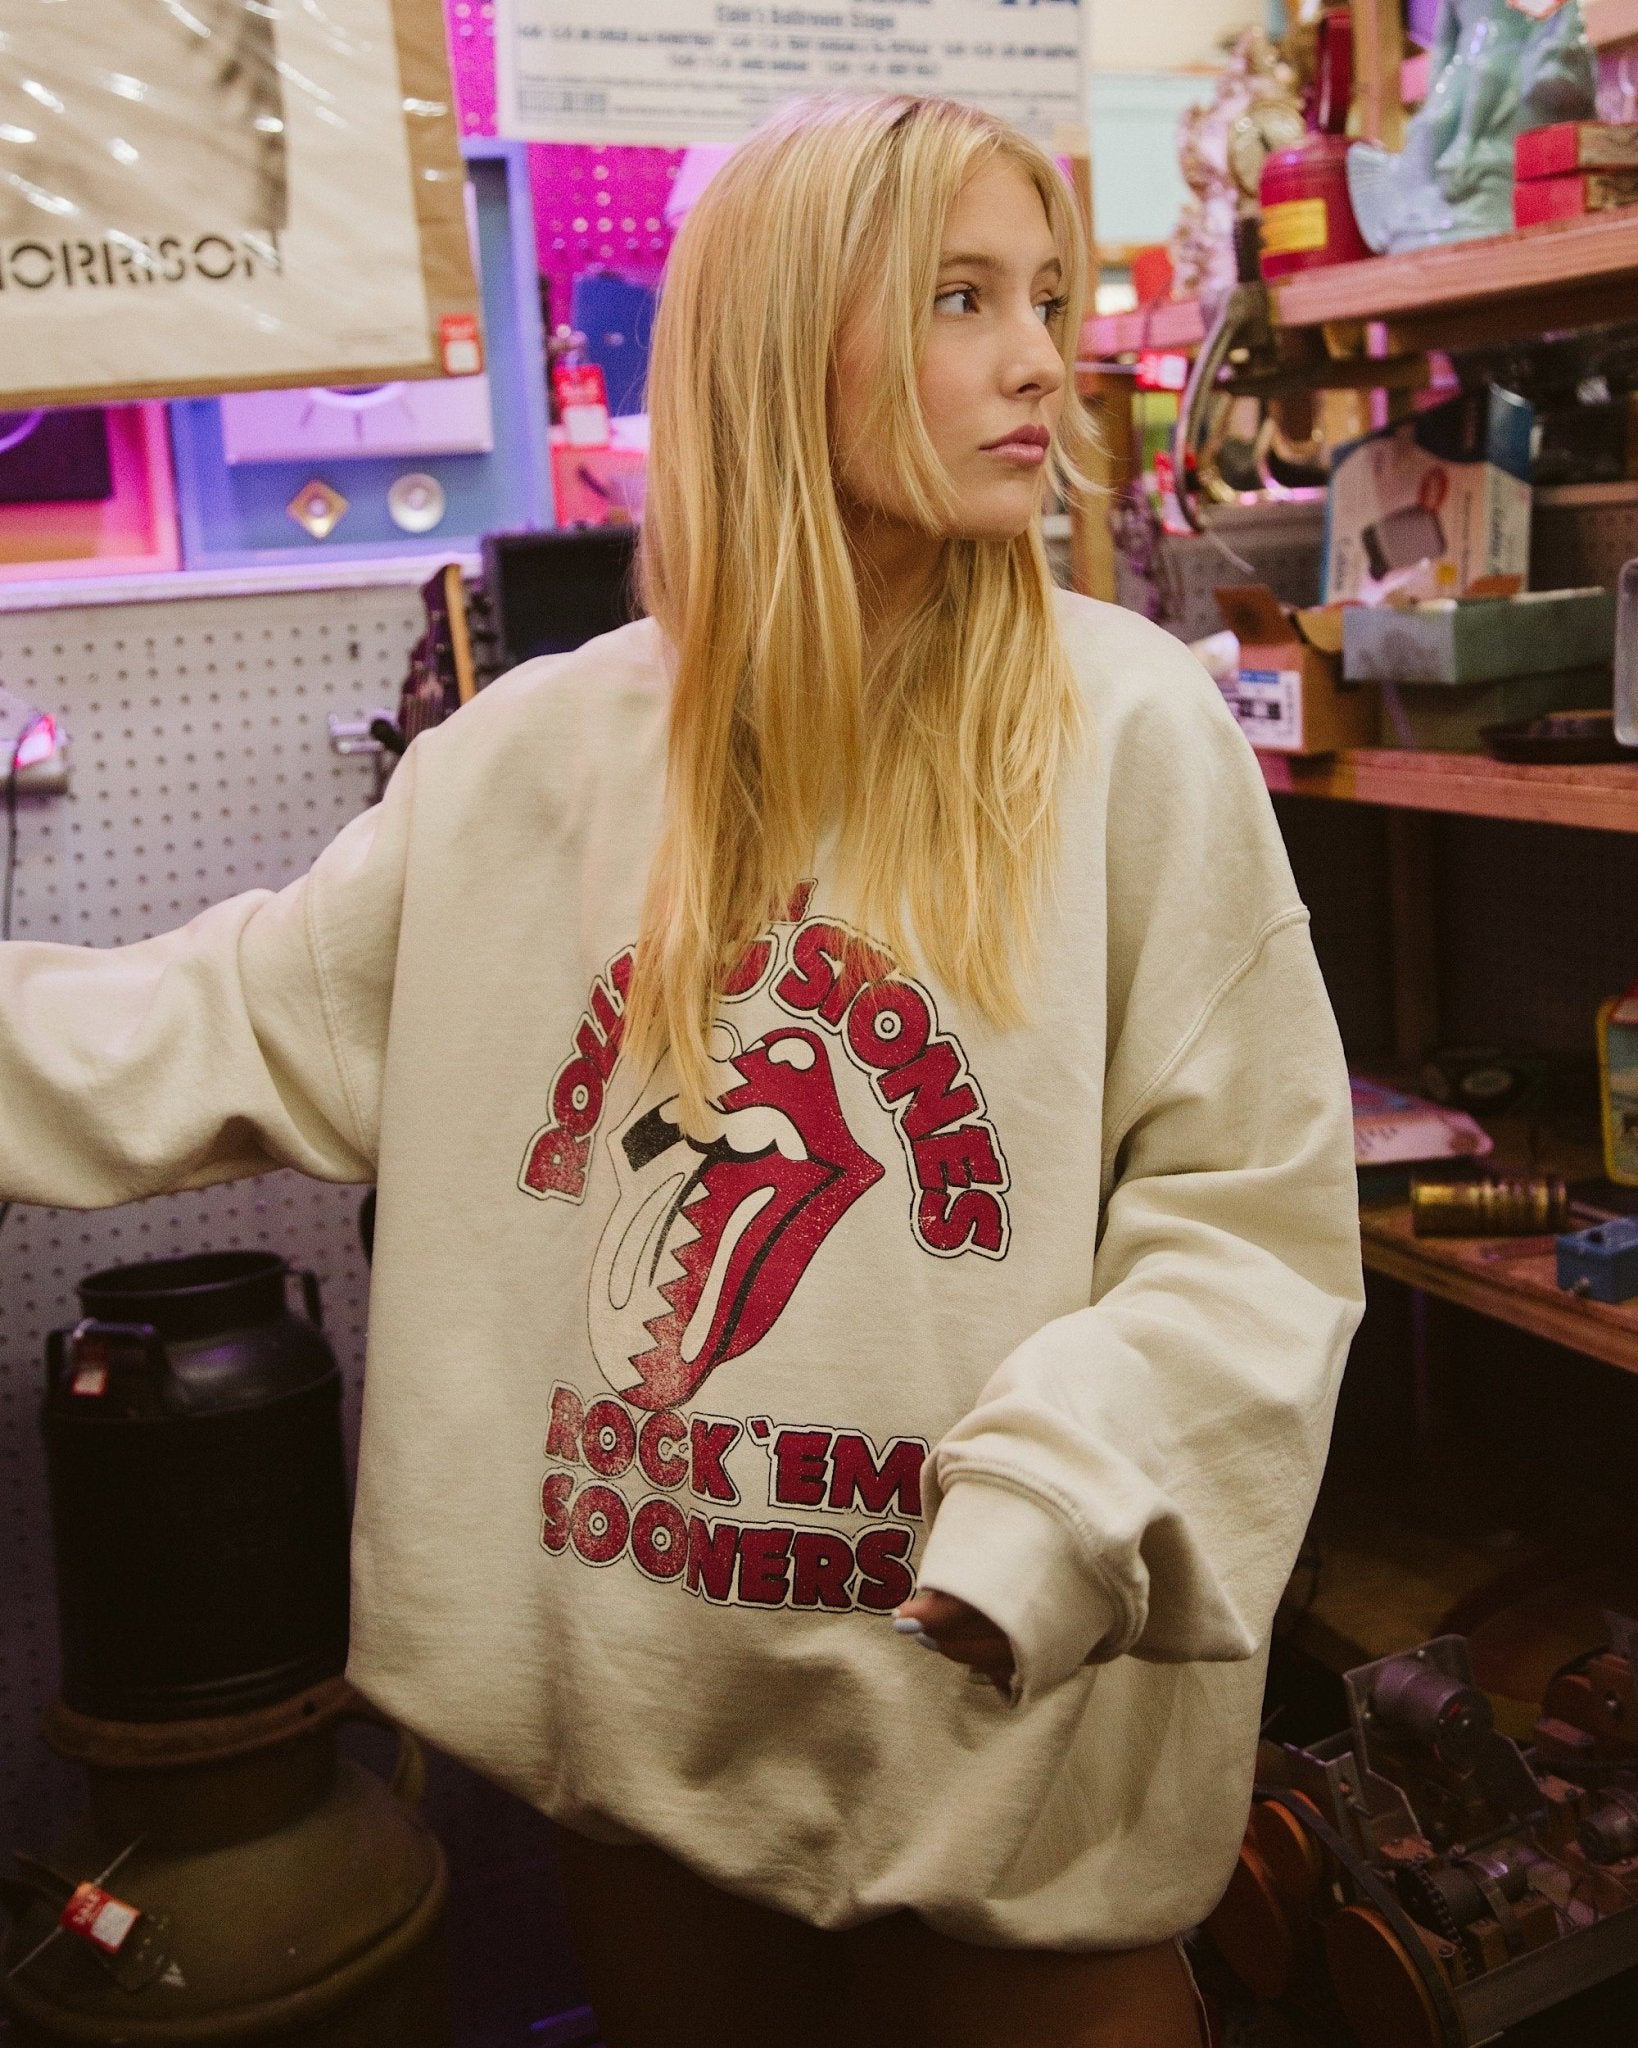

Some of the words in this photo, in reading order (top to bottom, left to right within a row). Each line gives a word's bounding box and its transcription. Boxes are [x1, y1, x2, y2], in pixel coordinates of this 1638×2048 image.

[0, 231, 282, 291] ORRISON
[768, 915, 1011, 1261] STONES
[544, 1380, 741, 1506] ROCK
[540, 1466, 917, 1615] SOONERS
